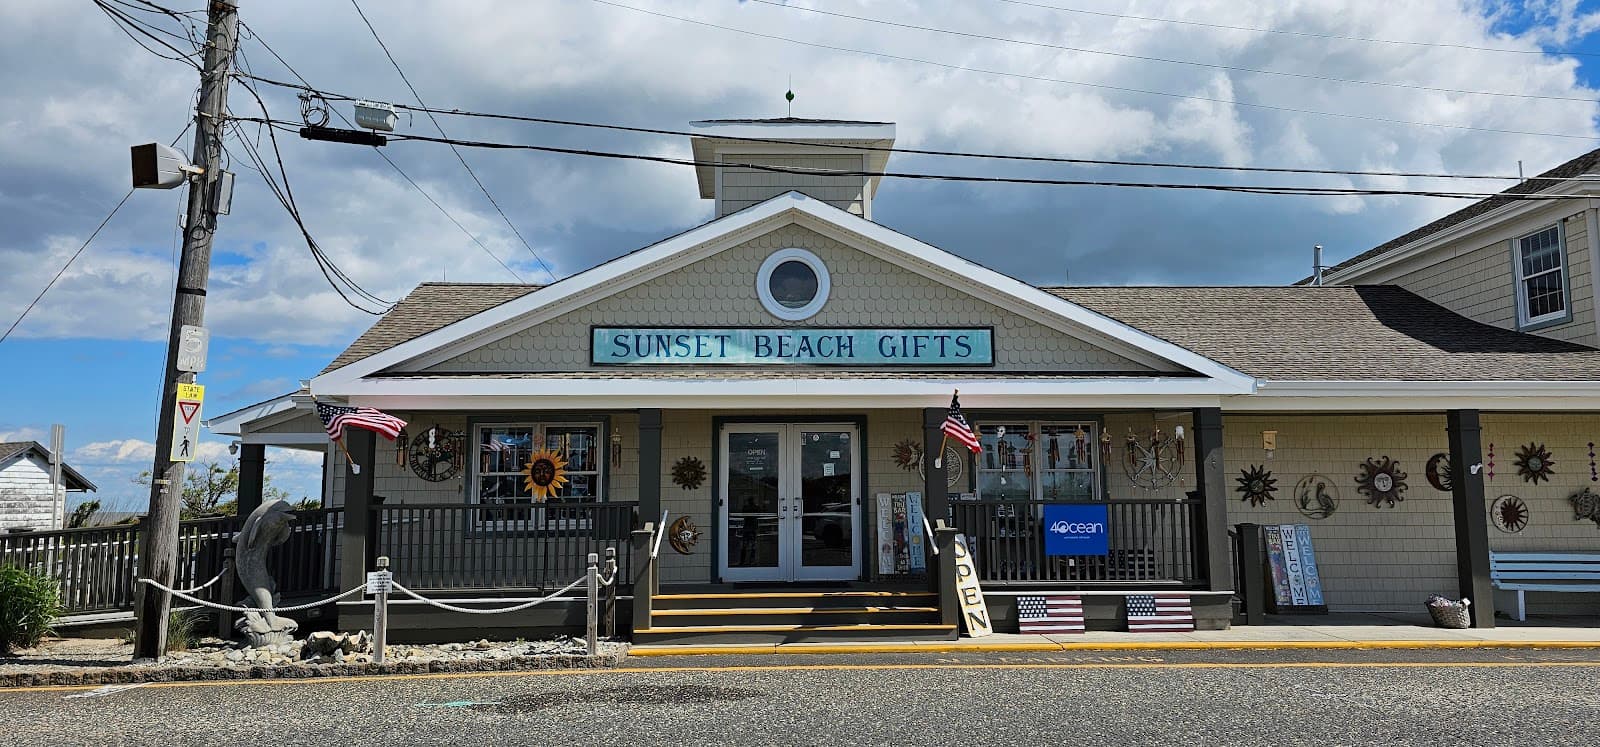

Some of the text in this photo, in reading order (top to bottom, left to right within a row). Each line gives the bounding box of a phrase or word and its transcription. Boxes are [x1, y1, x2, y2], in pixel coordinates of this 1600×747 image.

[611, 334, 973, 358] SUNSET BEACH GIFTS
[747, 448, 767, 456] OPEN
